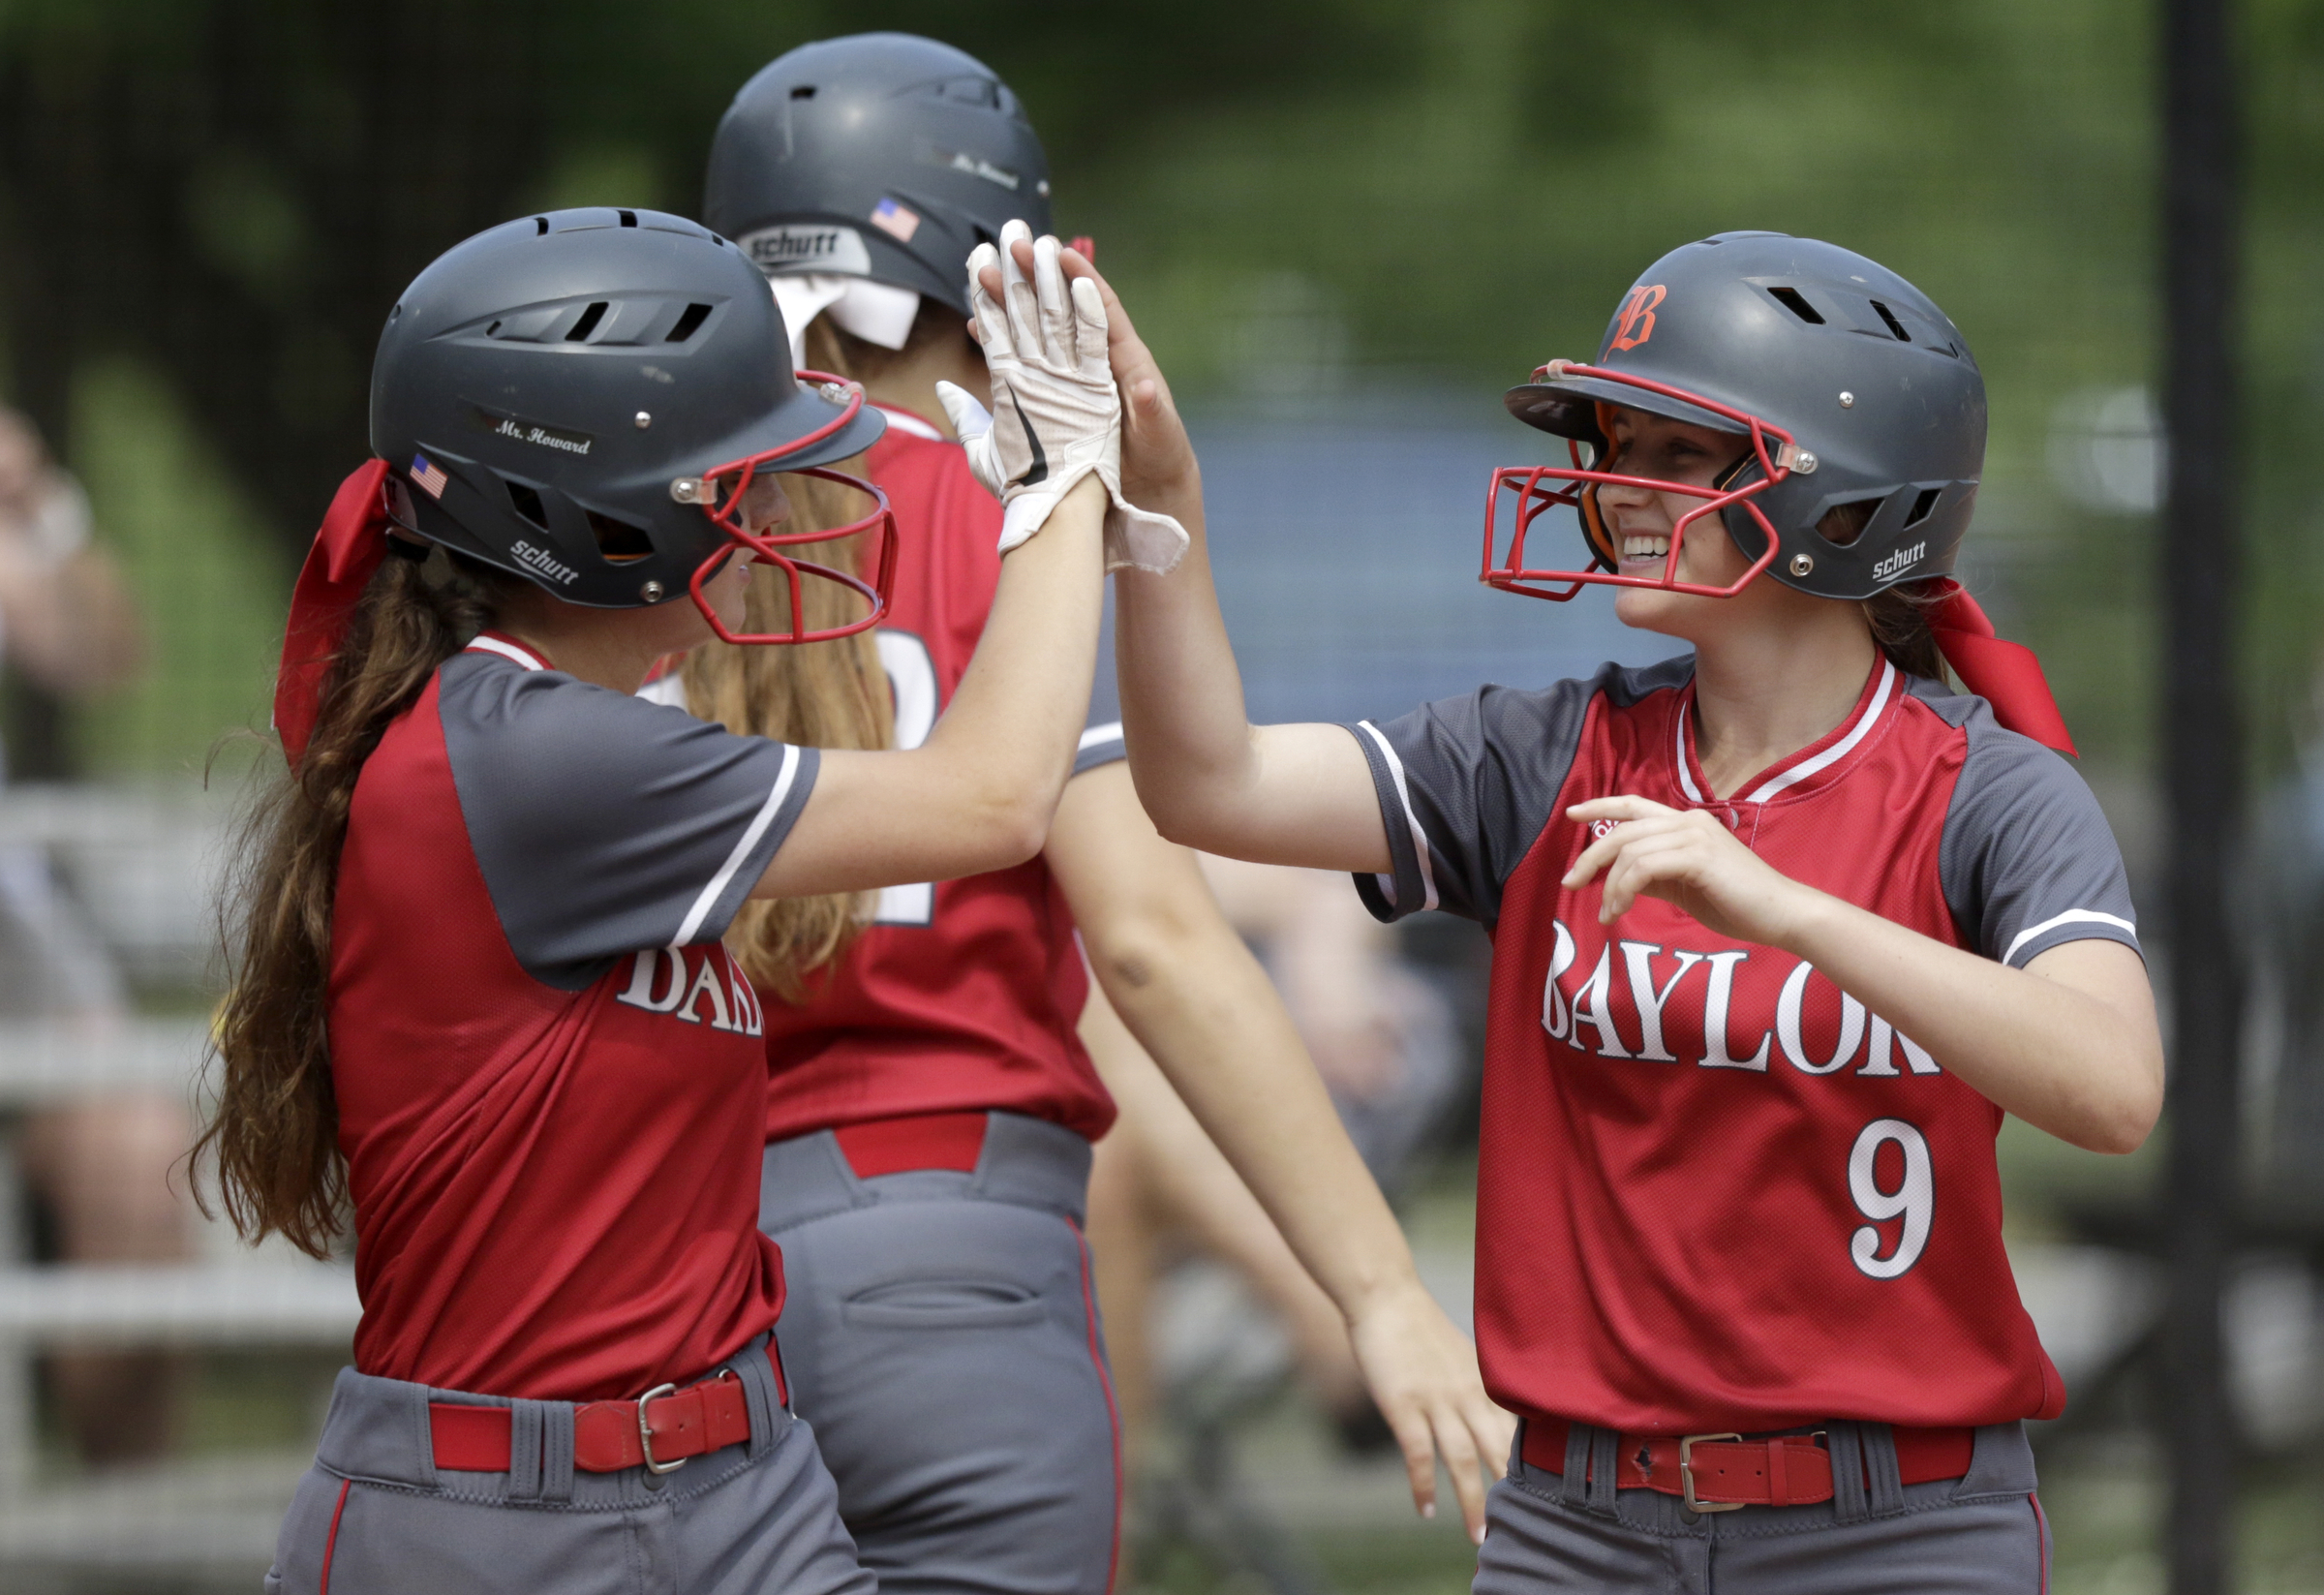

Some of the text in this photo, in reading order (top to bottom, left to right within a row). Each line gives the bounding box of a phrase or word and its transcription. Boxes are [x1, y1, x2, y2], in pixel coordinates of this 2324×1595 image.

[751, 230, 839, 259] schutt
[1603, 285, 1667, 363] B
[495, 419, 592, 455] Mr. Howard
[510, 539, 579, 585] schutt
[1872, 540, 1926, 580] schutt
[1848, 1117, 1936, 1281] 9
